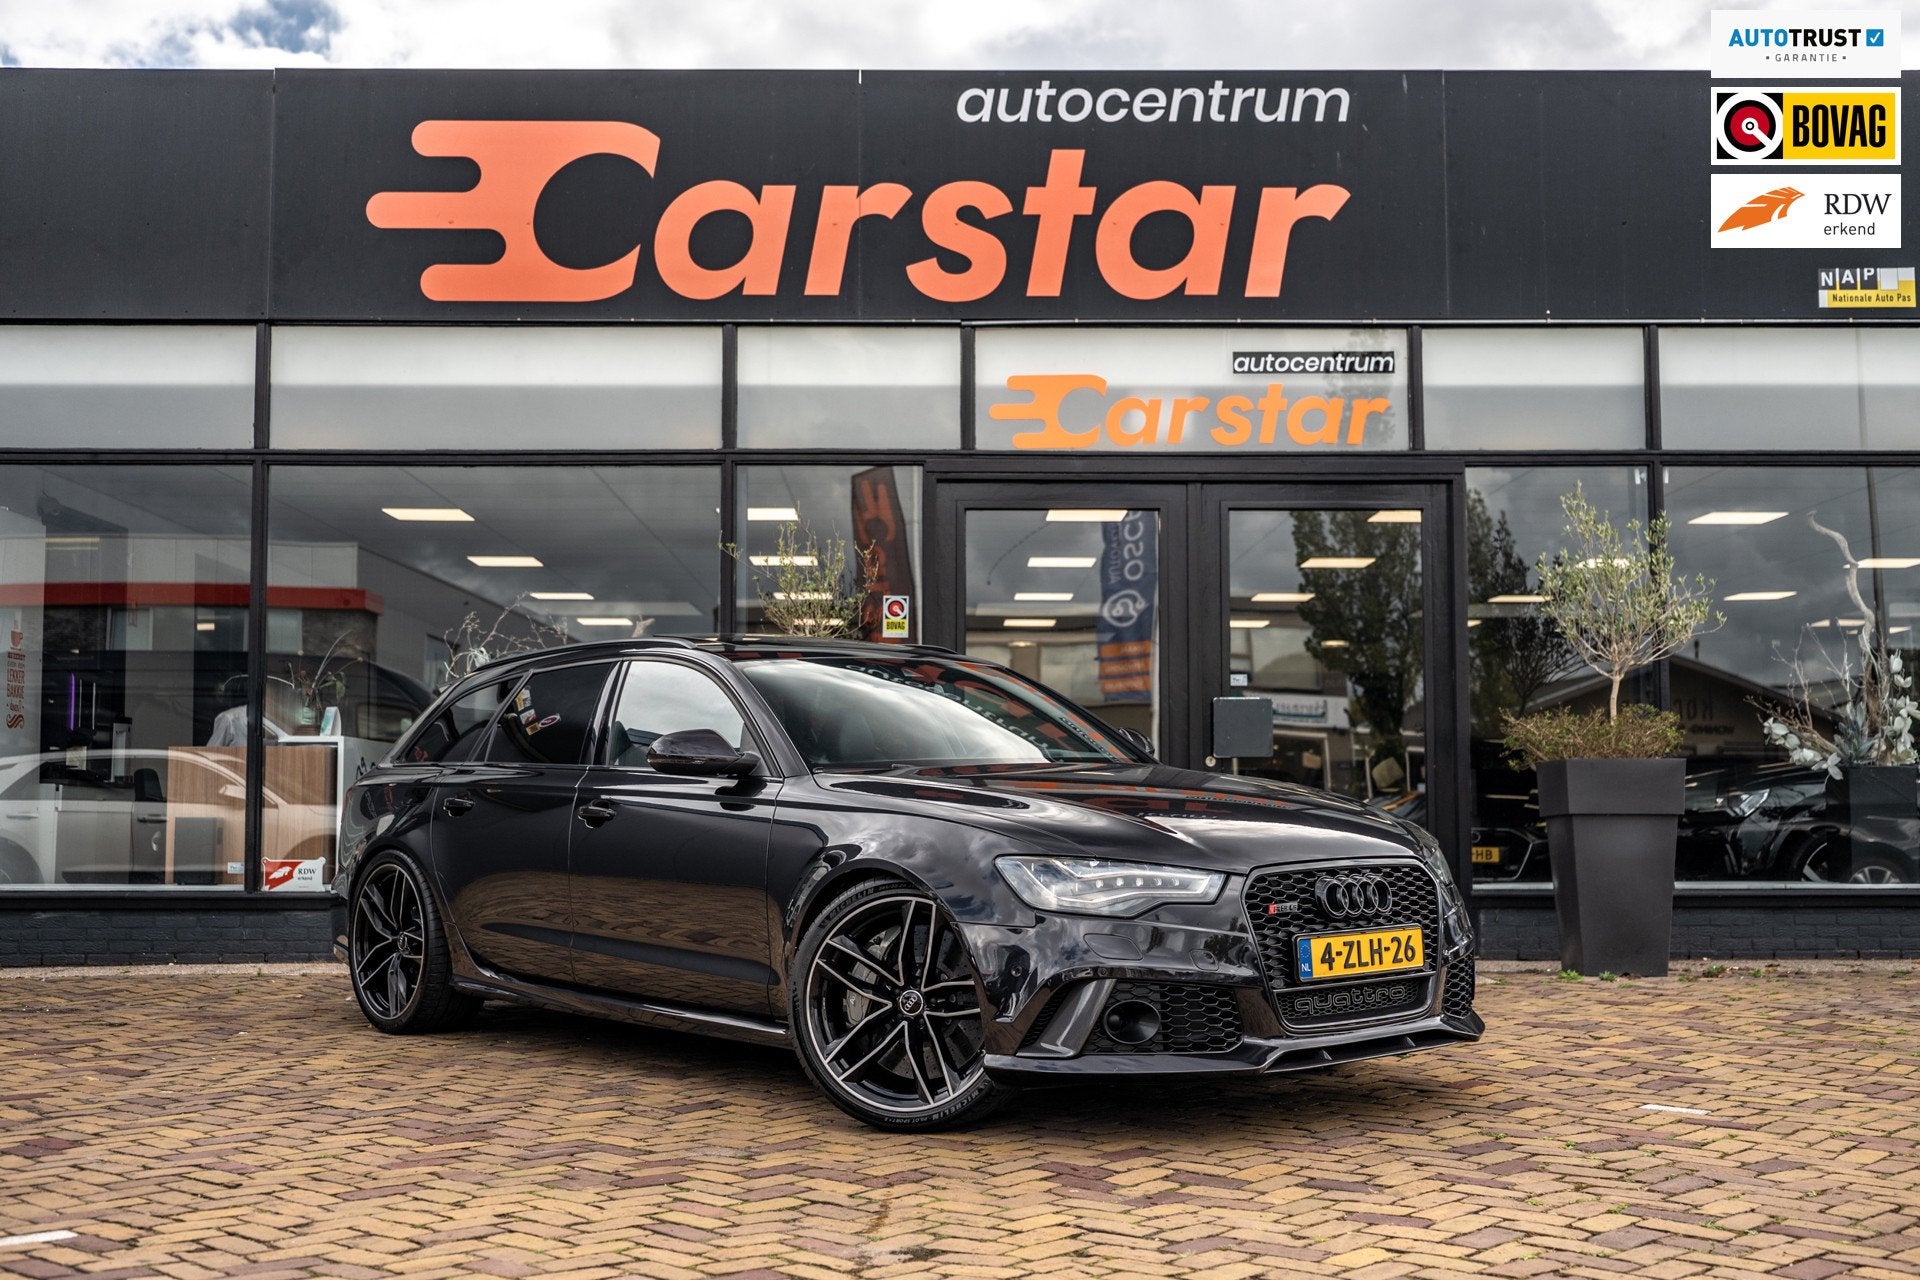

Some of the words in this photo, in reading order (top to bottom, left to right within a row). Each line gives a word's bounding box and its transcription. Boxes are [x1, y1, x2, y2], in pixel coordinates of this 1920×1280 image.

[956, 80, 1351, 125] autocentrum
[366, 120, 1351, 303] Carstar
[1832, 293, 1872, 303] Nationale
[1875, 292, 1894, 303] Auto
[1896, 292, 1912, 302] Pas
[1233, 353, 1394, 373] autocentrum
[988, 373, 1391, 450] Carstar
[1301, 963, 1312, 972] NL
[1320, 935, 1416, 971] 4-ZLH-26
[1294, 985, 1406, 1015] quattro
